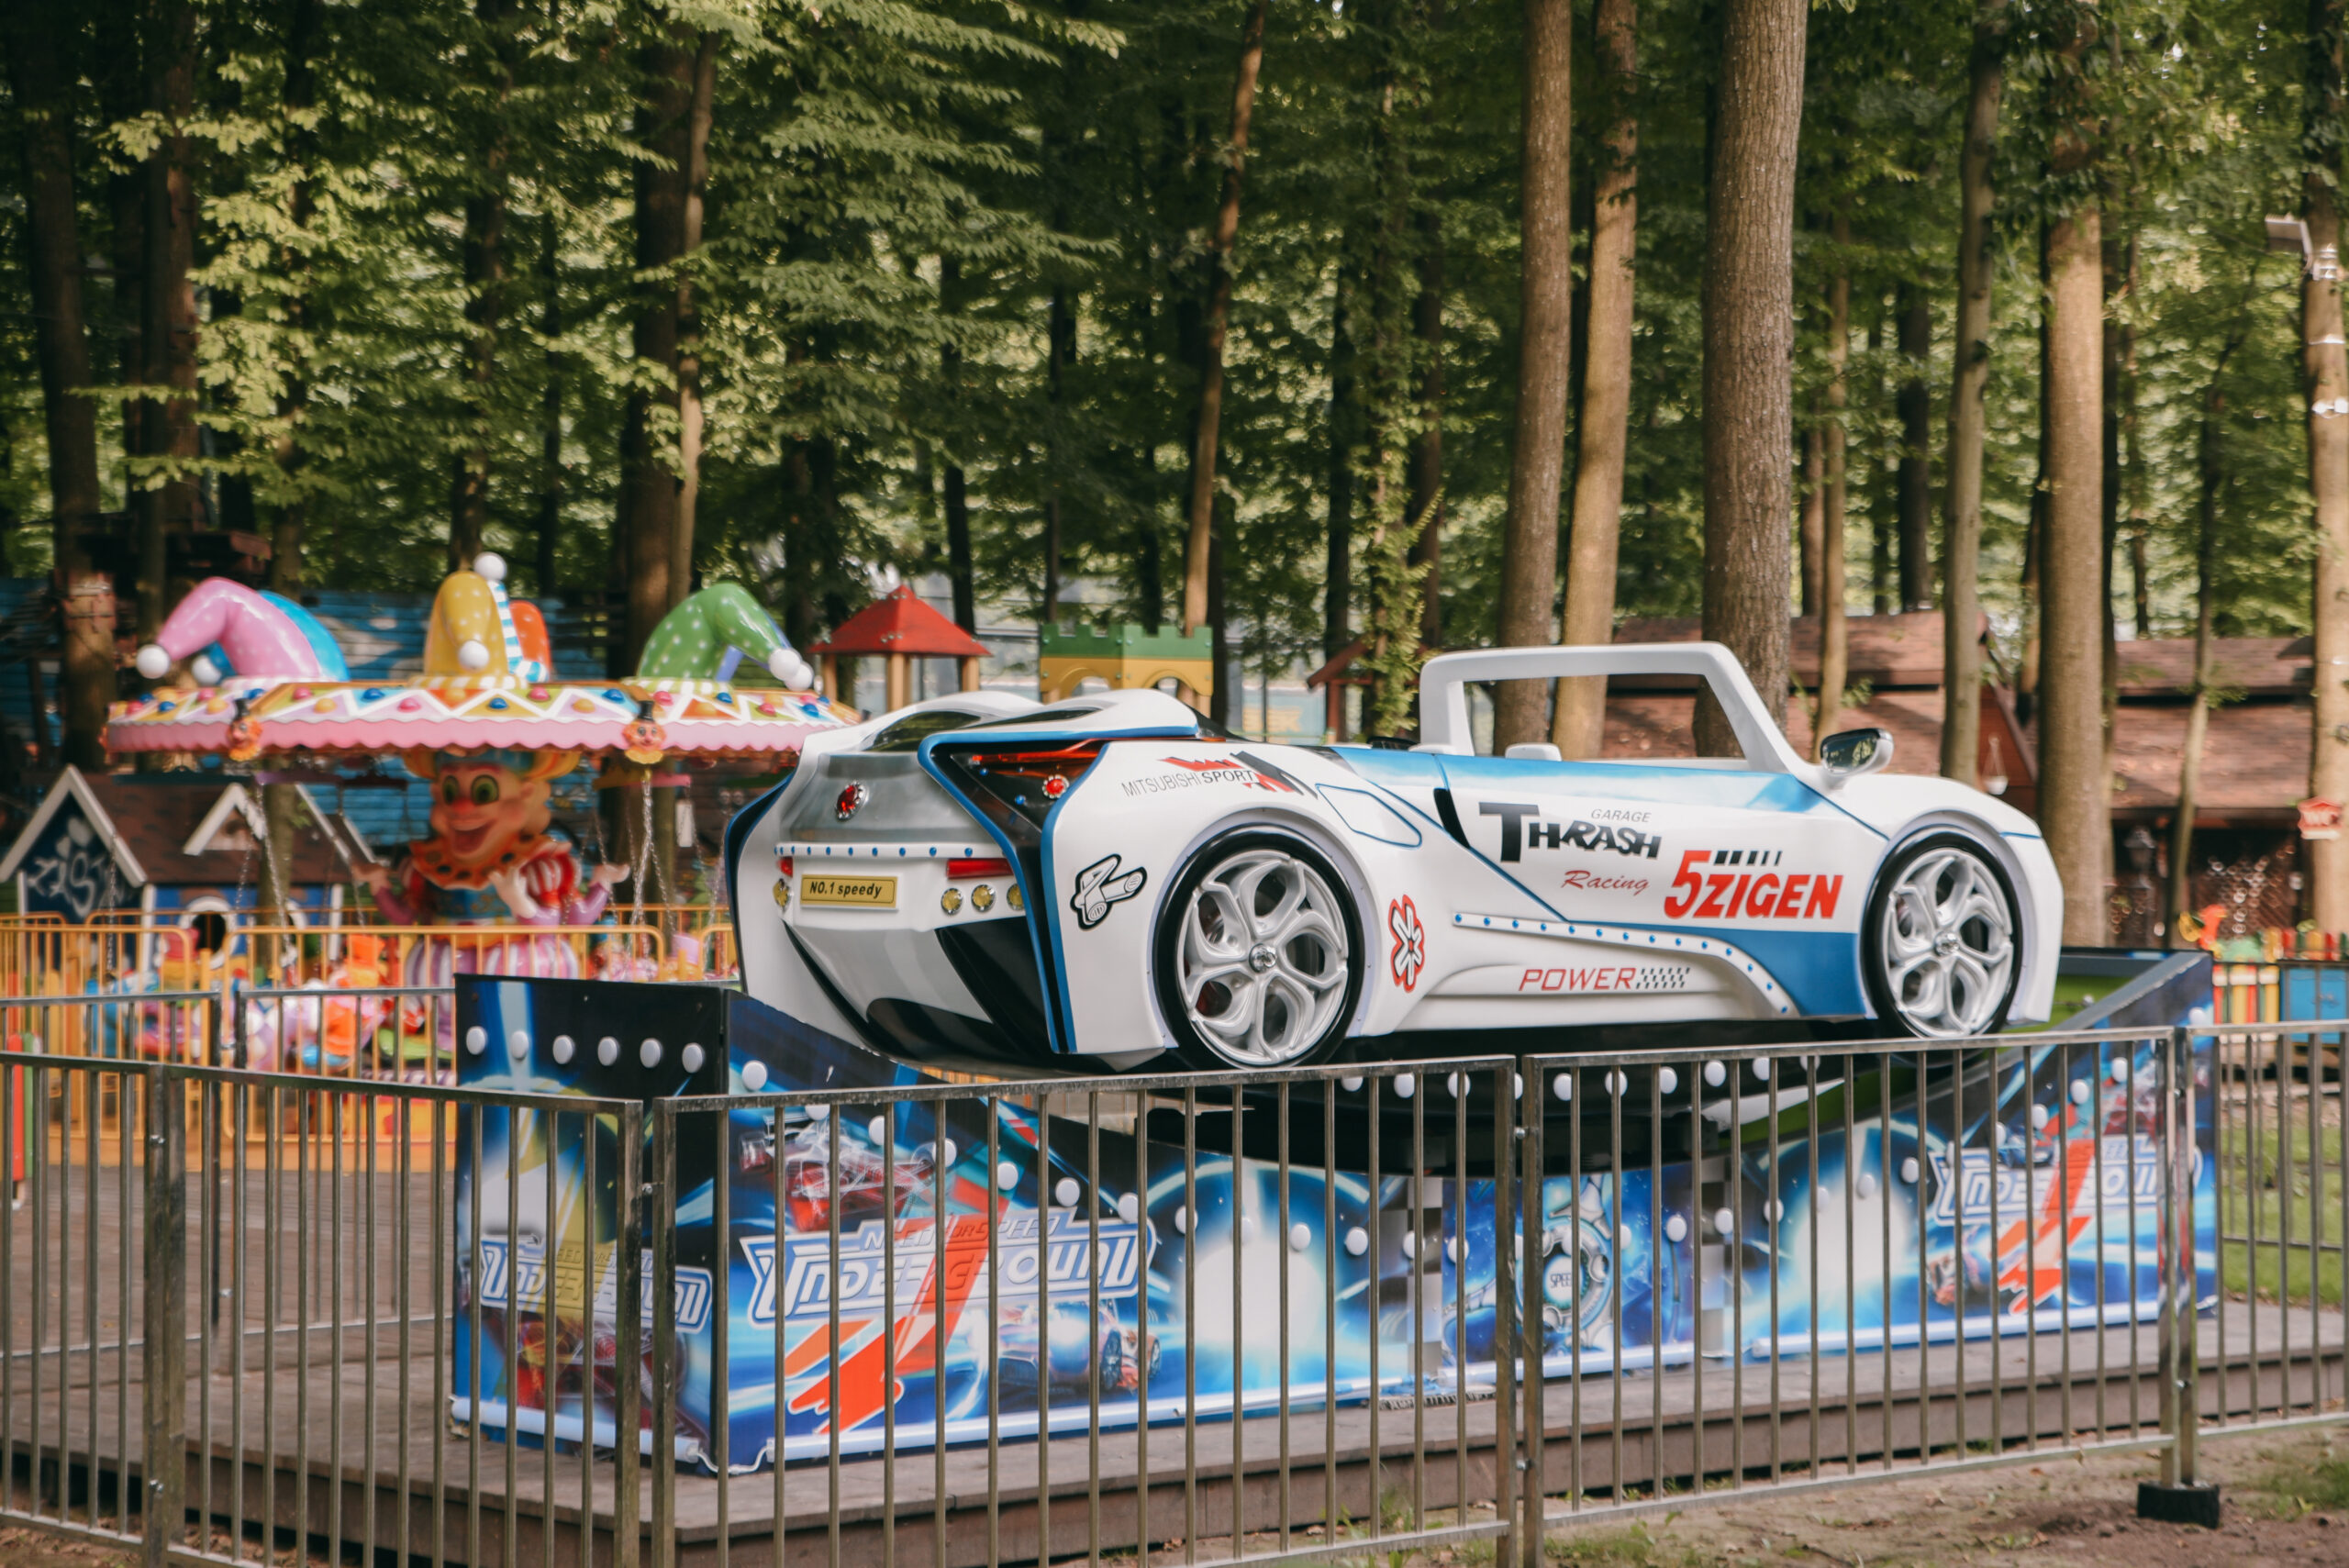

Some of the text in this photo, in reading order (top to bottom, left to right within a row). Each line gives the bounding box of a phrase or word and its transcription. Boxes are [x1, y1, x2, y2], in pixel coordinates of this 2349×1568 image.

[1121, 770, 1254, 797] MITSUBISHI SPORT
[1590, 808, 1652, 823] GARAGE
[1478, 801, 1662, 864] THRASH
[837, 883, 883, 899] speedy
[1561, 870, 1650, 896] Racing
[1664, 850, 1843, 919] 5ZIGEN
[1518, 967, 1636, 992] POWER
